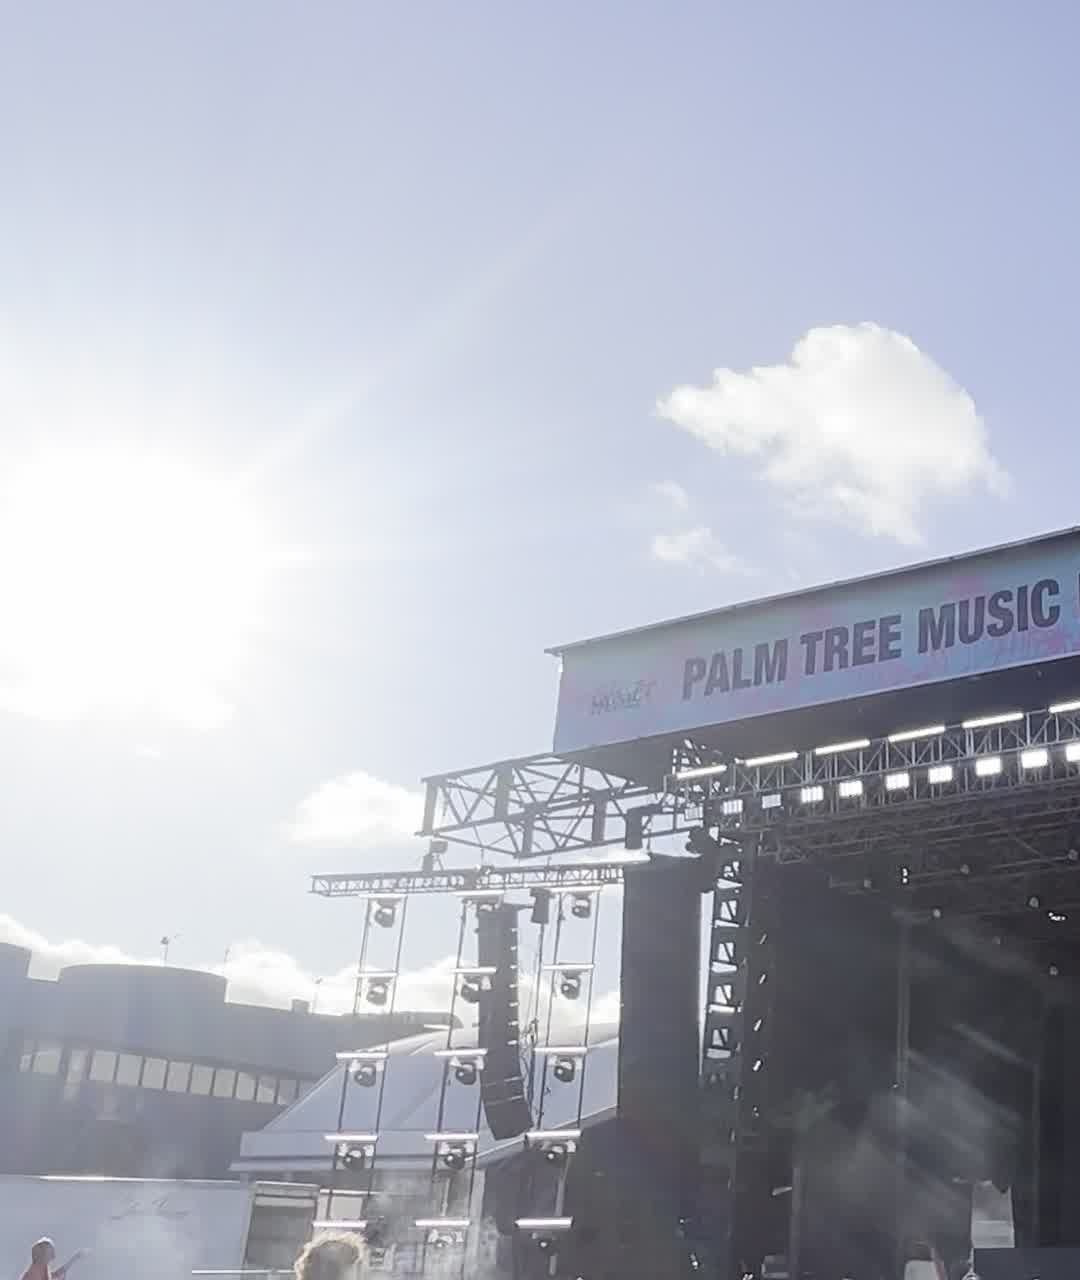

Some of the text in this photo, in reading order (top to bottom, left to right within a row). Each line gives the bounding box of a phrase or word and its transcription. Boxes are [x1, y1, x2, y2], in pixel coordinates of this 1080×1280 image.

[681, 638, 788, 701] PALM
[800, 615, 902, 676] TREE
[917, 578, 1061, 654] MUSIC
